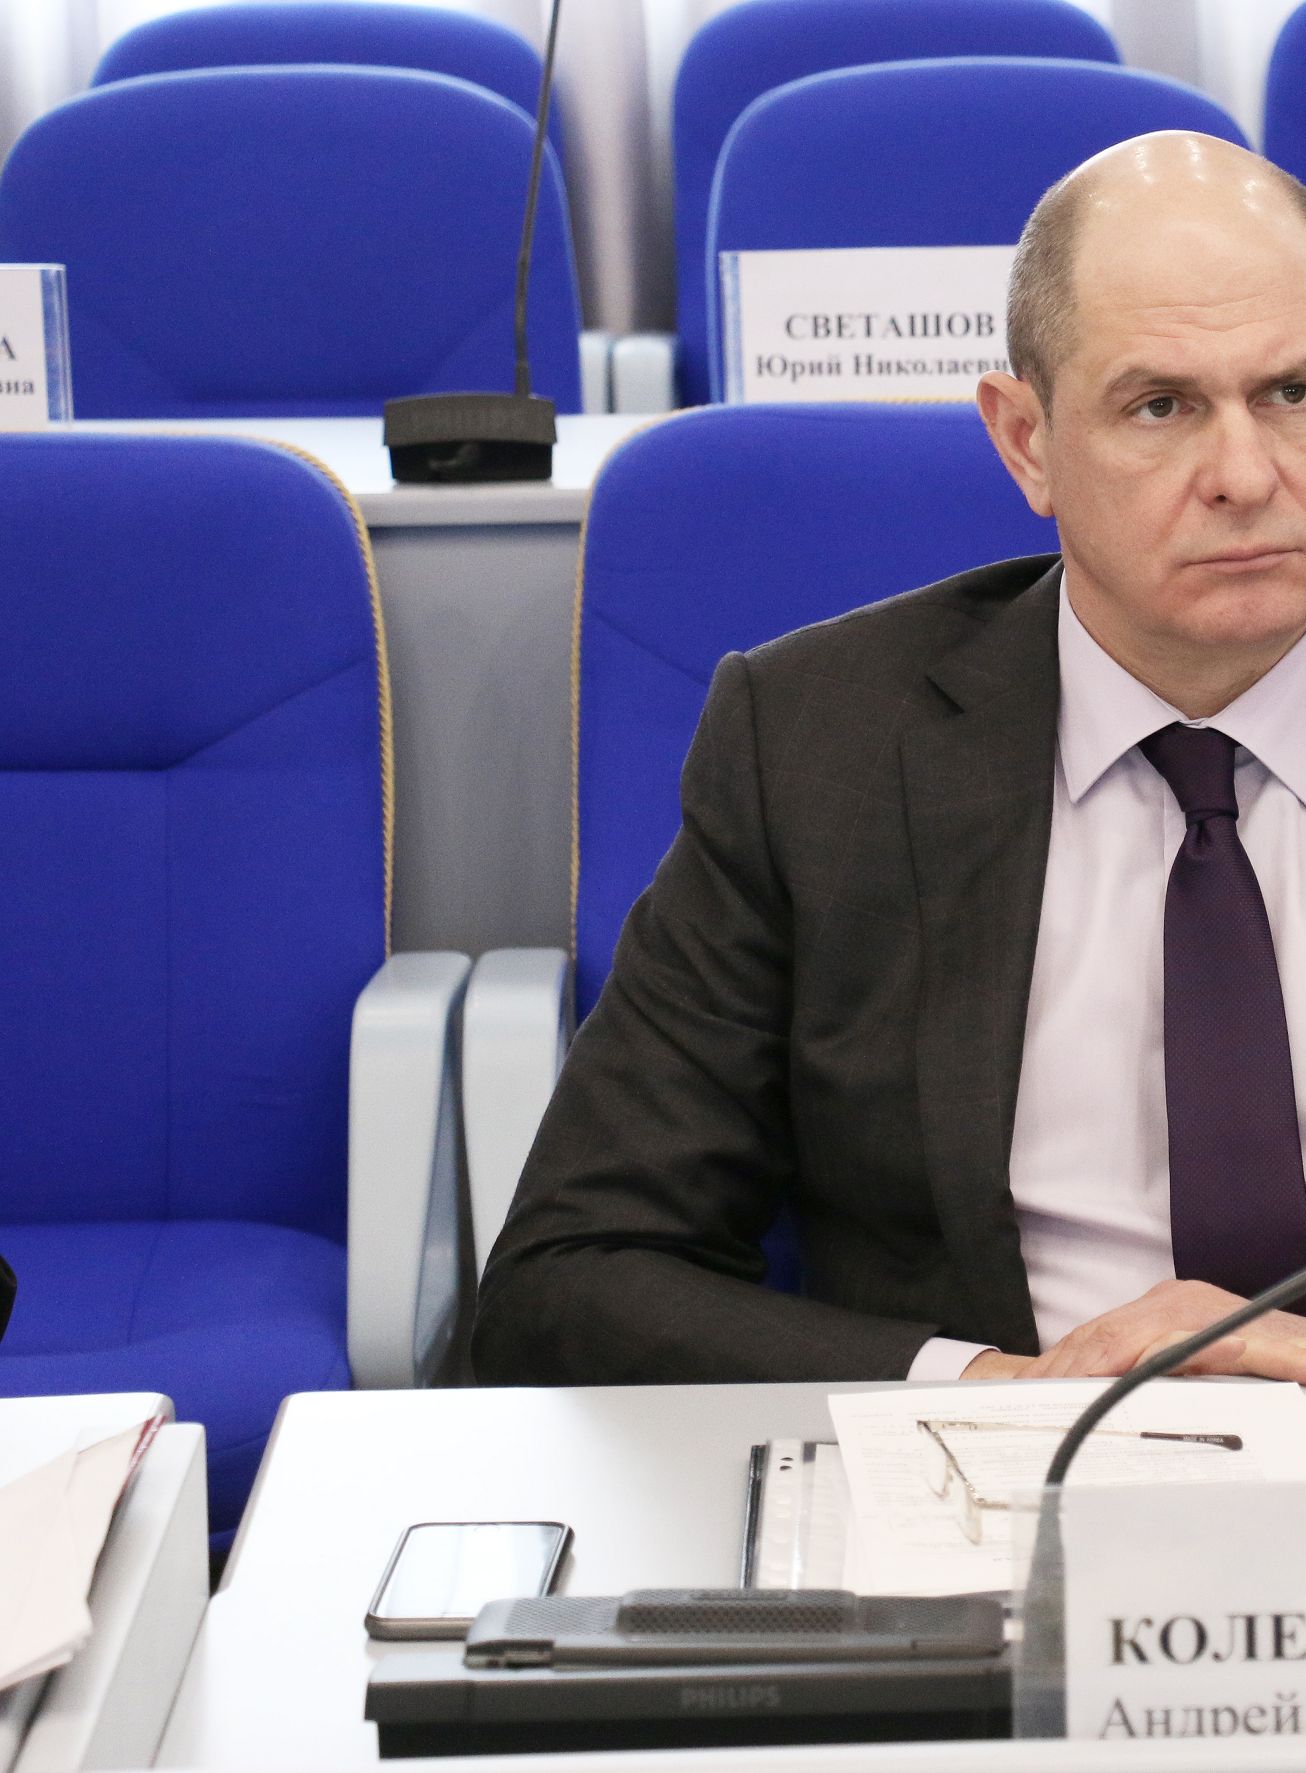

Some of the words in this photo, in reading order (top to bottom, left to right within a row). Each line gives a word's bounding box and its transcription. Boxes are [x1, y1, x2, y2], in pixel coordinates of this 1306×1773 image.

[784, 312, 995, 341] СВЕТАШОВ
[756, 353, 842, 383] Юрий
[854, 352, 1009, 376] Николаеви
[0, 380, 35, 394] на
[680, 1685, 782, 1709] PHILIPS
[1099, 1691, 1303, 1740] Андрей
